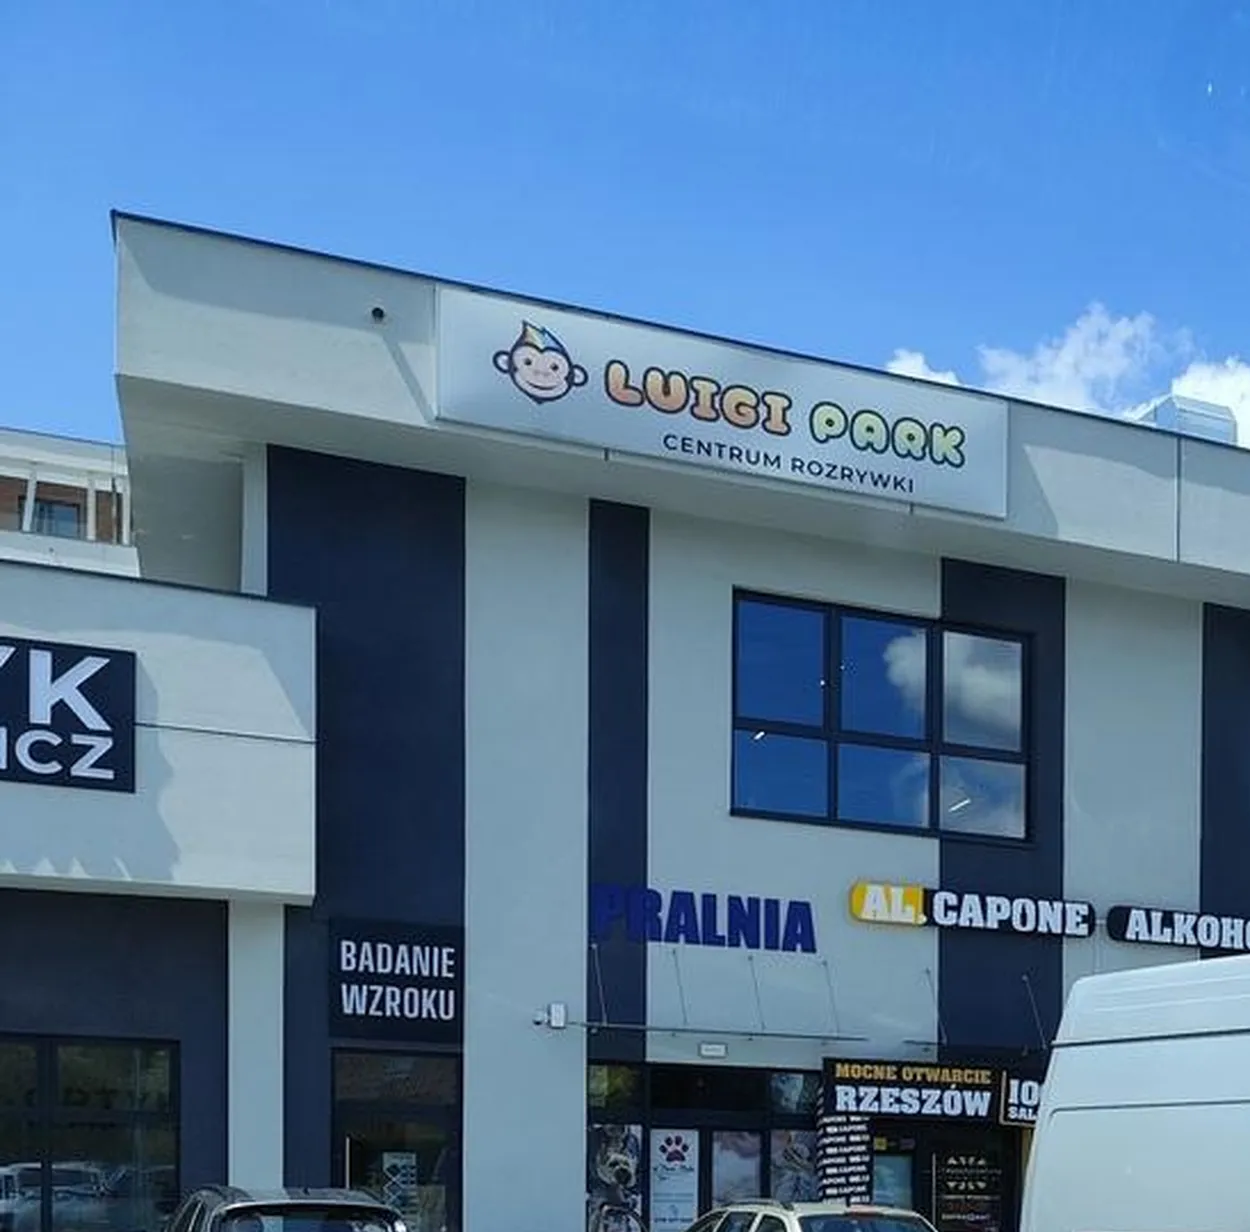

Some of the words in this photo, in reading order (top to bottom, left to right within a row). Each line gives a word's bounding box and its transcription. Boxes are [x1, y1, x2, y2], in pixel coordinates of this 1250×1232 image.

[604, 360, 793, 436] LUIGI
[808, 401, 966, 468] PARK
[663, 434, 782, 470] CENTRUM
[791, 458, 914, 493] ROZRYWKI
[0, 645, 112, 731] K
[592, 884, 817, 953] PRALNIA
[932, 891, 1089, 936] CAPONE
[340, 940, 455, 978] BADANIE
[341, 984, 455, 1021] WZROKU
[835, 1063, 897, 1080] MOCNE
[902, 1066, 991, 1084] OTWARCIE
[835, 1083, 992, 1116] RZESZÓW
